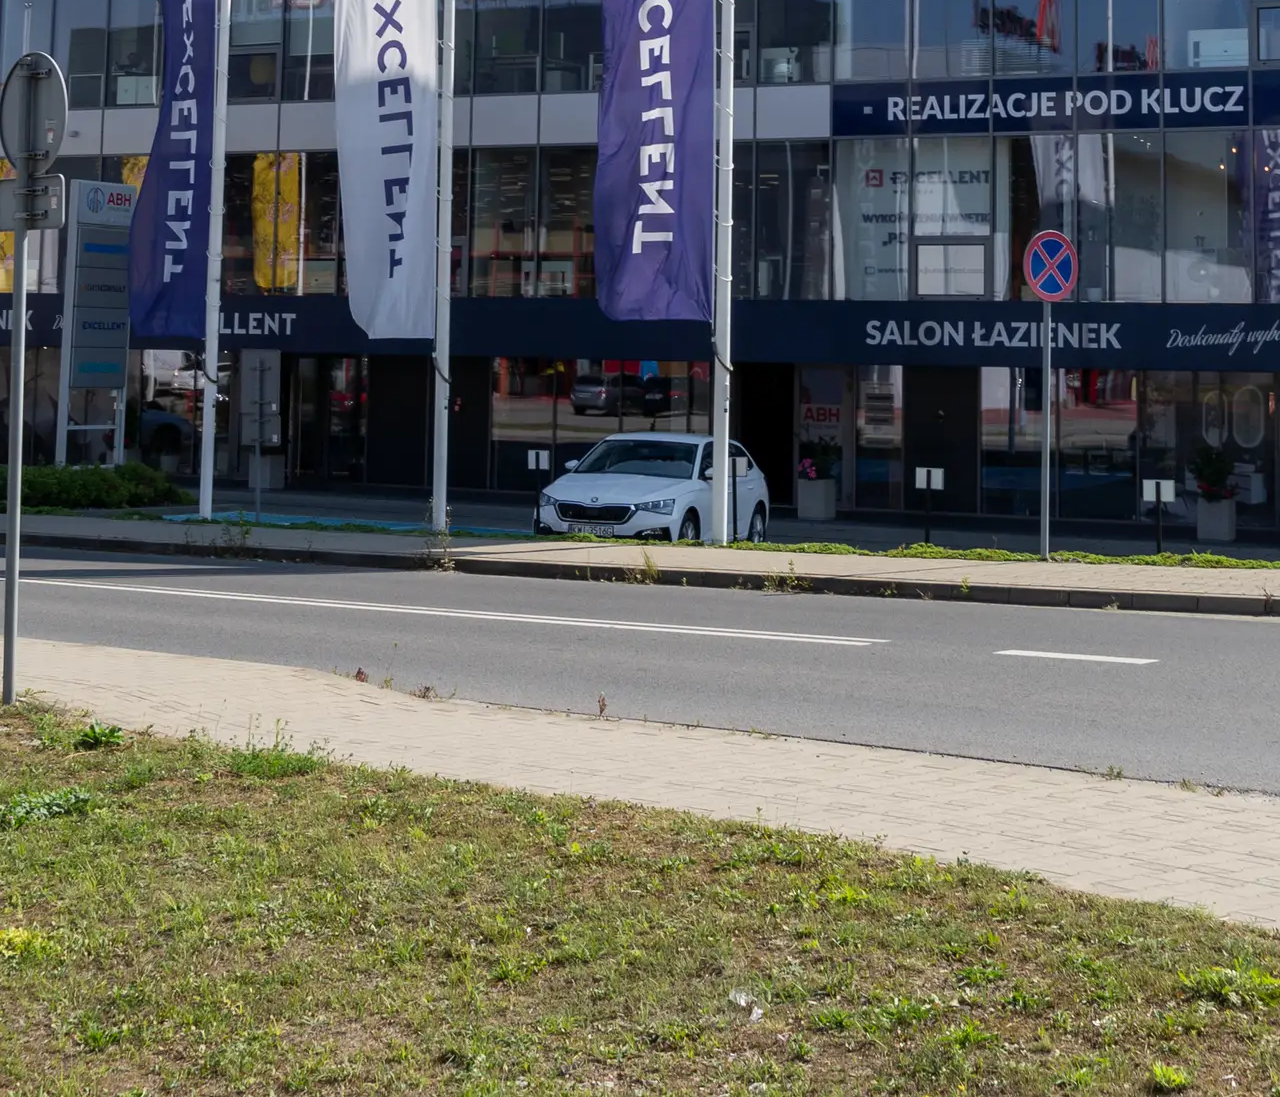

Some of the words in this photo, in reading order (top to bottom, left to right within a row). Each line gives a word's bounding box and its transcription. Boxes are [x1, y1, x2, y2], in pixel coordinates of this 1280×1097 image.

[886, 92, 1057, 122] REALIZACJE
[1065, 89, 1133, 116] POD
[1140, 84, 1245, 115] KLUCZ
[106, 191, 132, 207] ABH
[865, 320, 964, 347] SALON
[971, 320, 1122, 349] ŁAZIENEK
[1166, 322, 1246, 356] Doskonały
[804, 407, 840, 423] ABH
